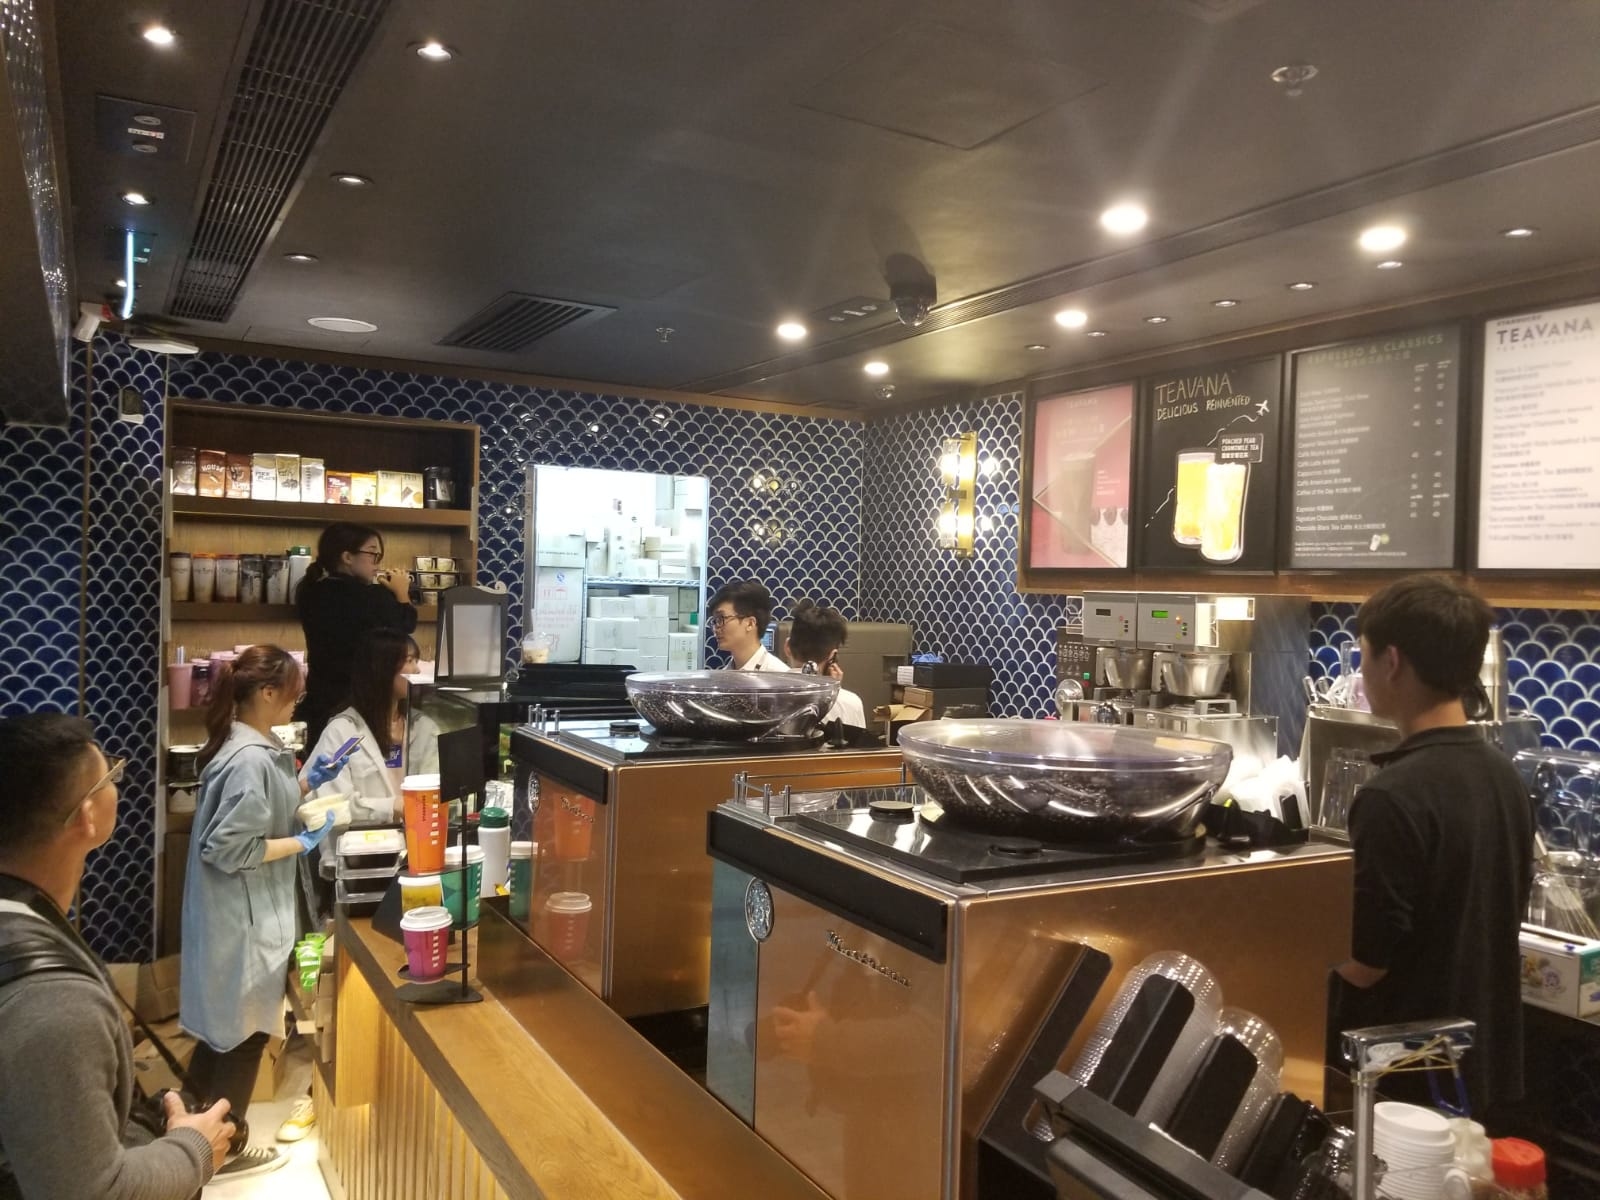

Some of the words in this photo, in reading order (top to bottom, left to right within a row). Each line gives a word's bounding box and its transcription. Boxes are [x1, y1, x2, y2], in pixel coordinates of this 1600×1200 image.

[1383, 334, 1443, 351] CLASSICS
[1496, 317, 1593, 345] TEAVANA
[1154, 371, 1233, 406] TEAVANA
[1157, 402, 1199, 421] DELICIOUS
[1206, 394, 1251, 411] REINVENTED
